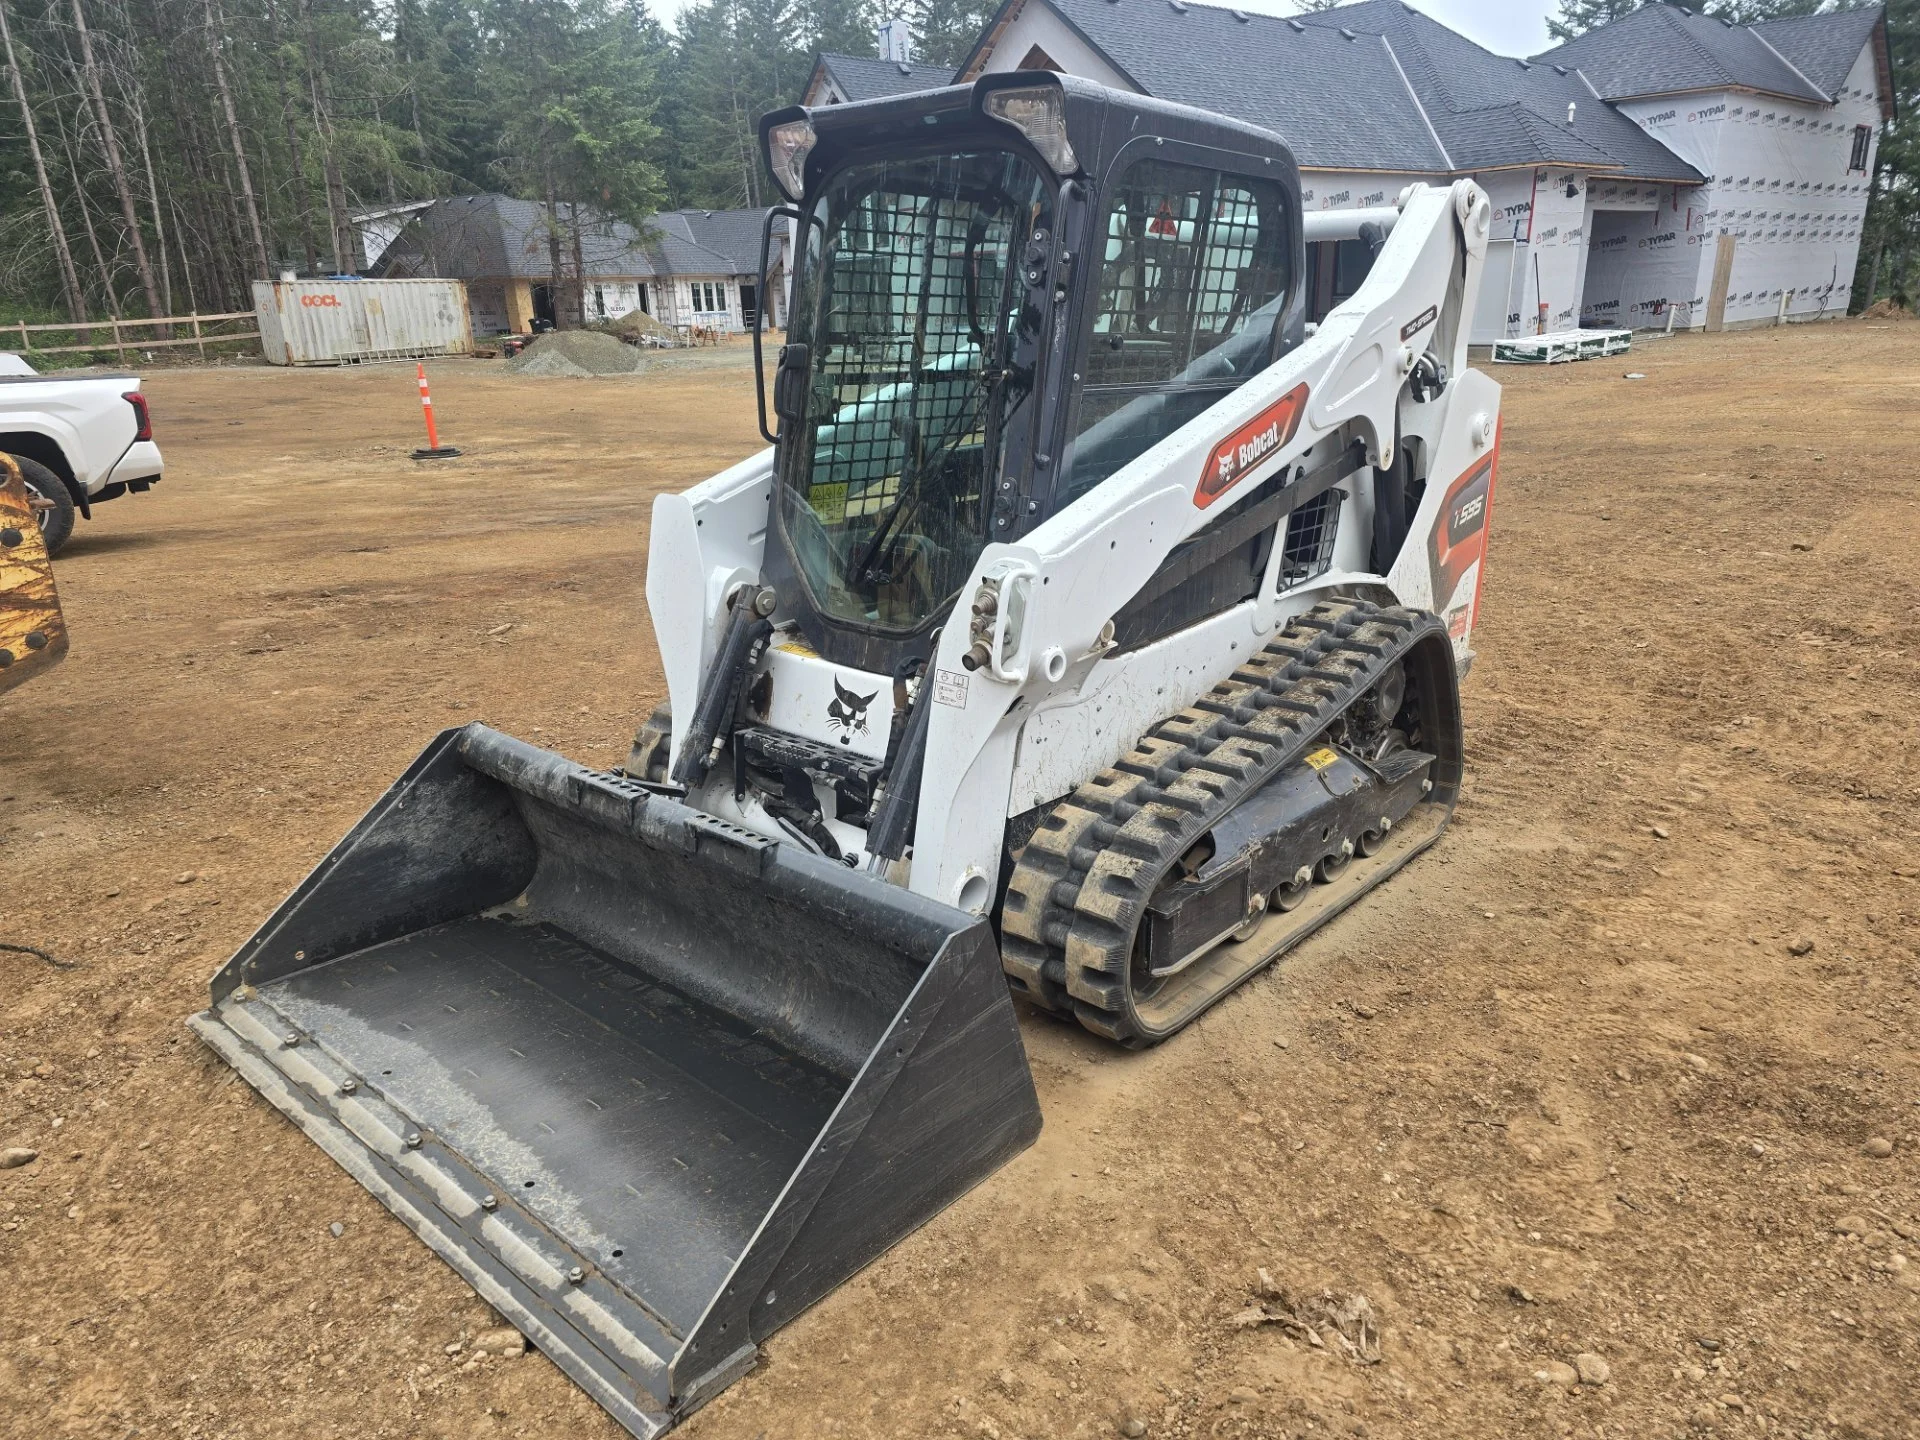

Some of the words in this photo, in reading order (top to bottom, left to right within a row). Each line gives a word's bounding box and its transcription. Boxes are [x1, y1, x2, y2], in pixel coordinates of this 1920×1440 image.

[1648, 110, 1676, 125] TYPAR
[1698, 104, 1726, 119] TYPAR
[1300, 190, 1314, 203] PAR
[1328, 191, 1350, 206] TYPAR
[1364, 192, 1384, 207] TYPAR
[1504, 202, 1531, 217] TYPA
[1600, 235, 1628, 249] TYPAR
[1649, 232, 1676, 246] TYPAR
[1592, 300, 1620, 312] TYPAR
[1639, 298, 1667, 311] TYPAR
[1238, 421, 1279, 470] Bobcat
